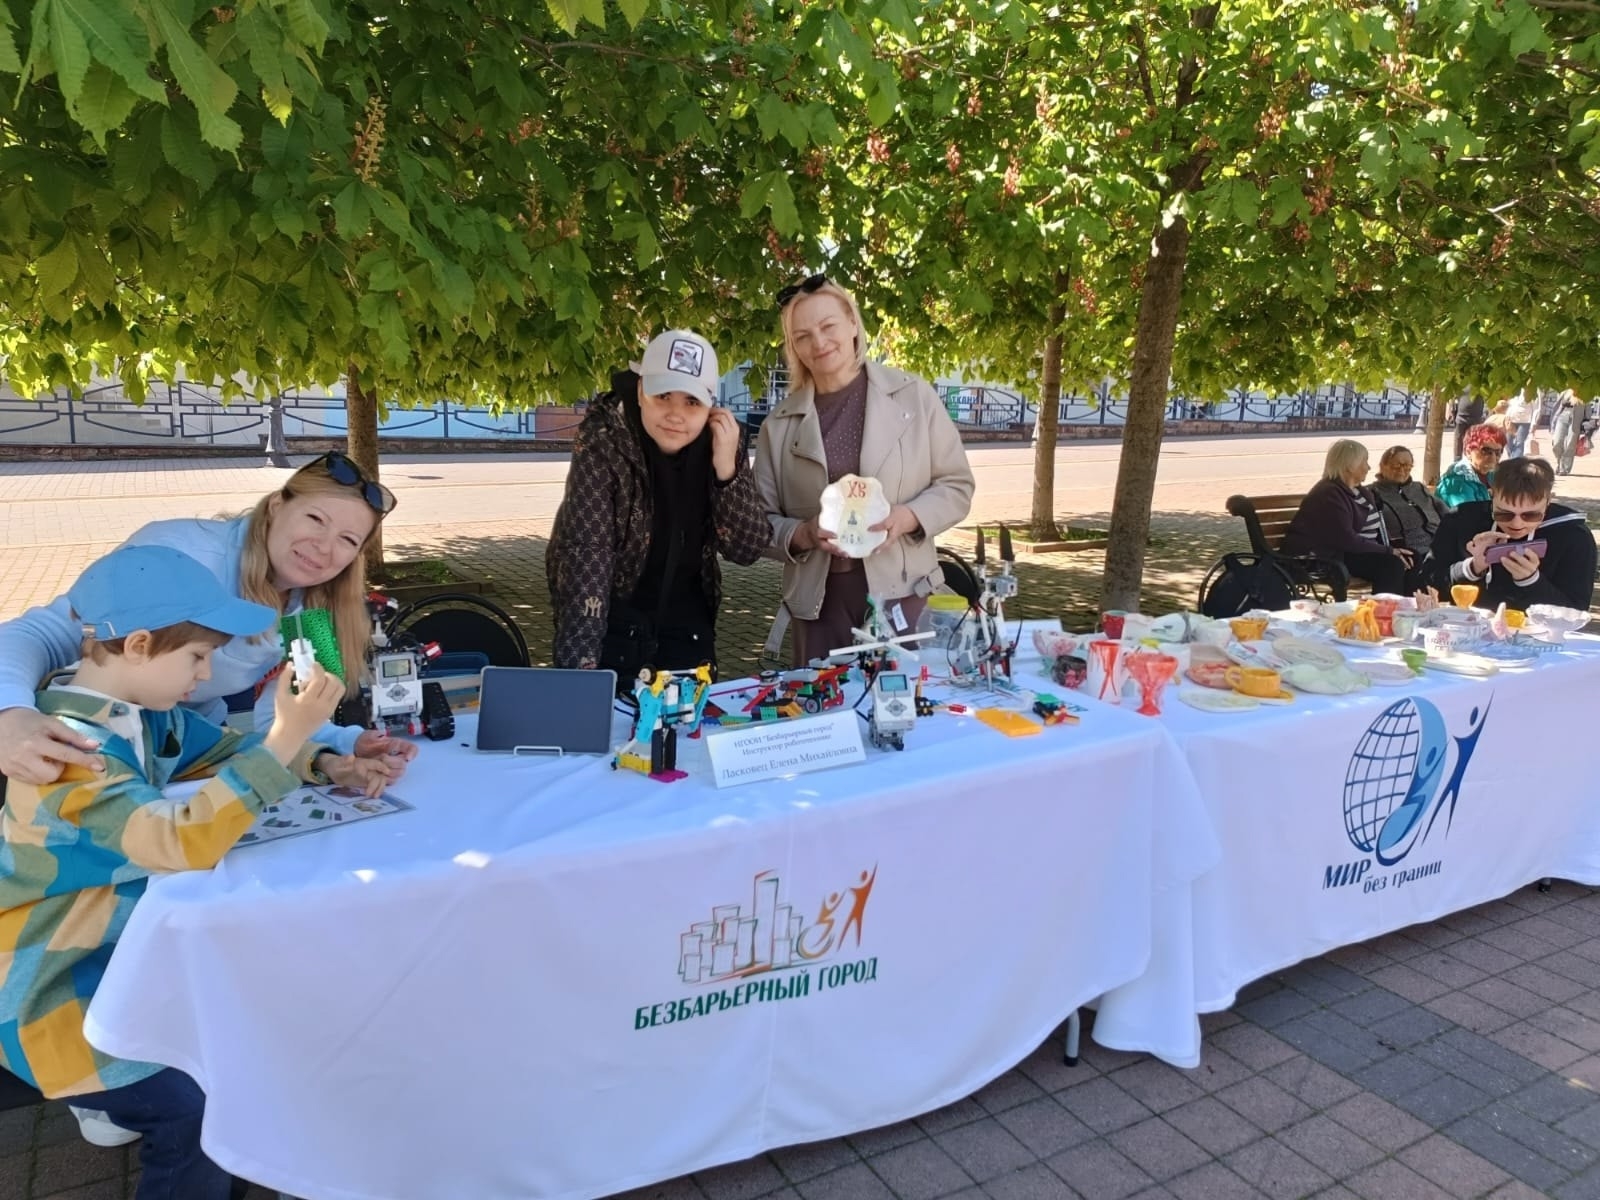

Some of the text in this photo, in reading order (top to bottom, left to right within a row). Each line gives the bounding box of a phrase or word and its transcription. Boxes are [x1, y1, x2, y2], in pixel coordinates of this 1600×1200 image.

[722, 746, 858, 779] Ласковец Елена Михайловна
[742, 743, 783, 756] Инструктор
[1322, 858, 1372, 890] МИР
[1363, 860, 1442, 894] без границ
[634, 956, 878, 1031] БЕЗБАРЬЕРНЫЙ ГОРОД
